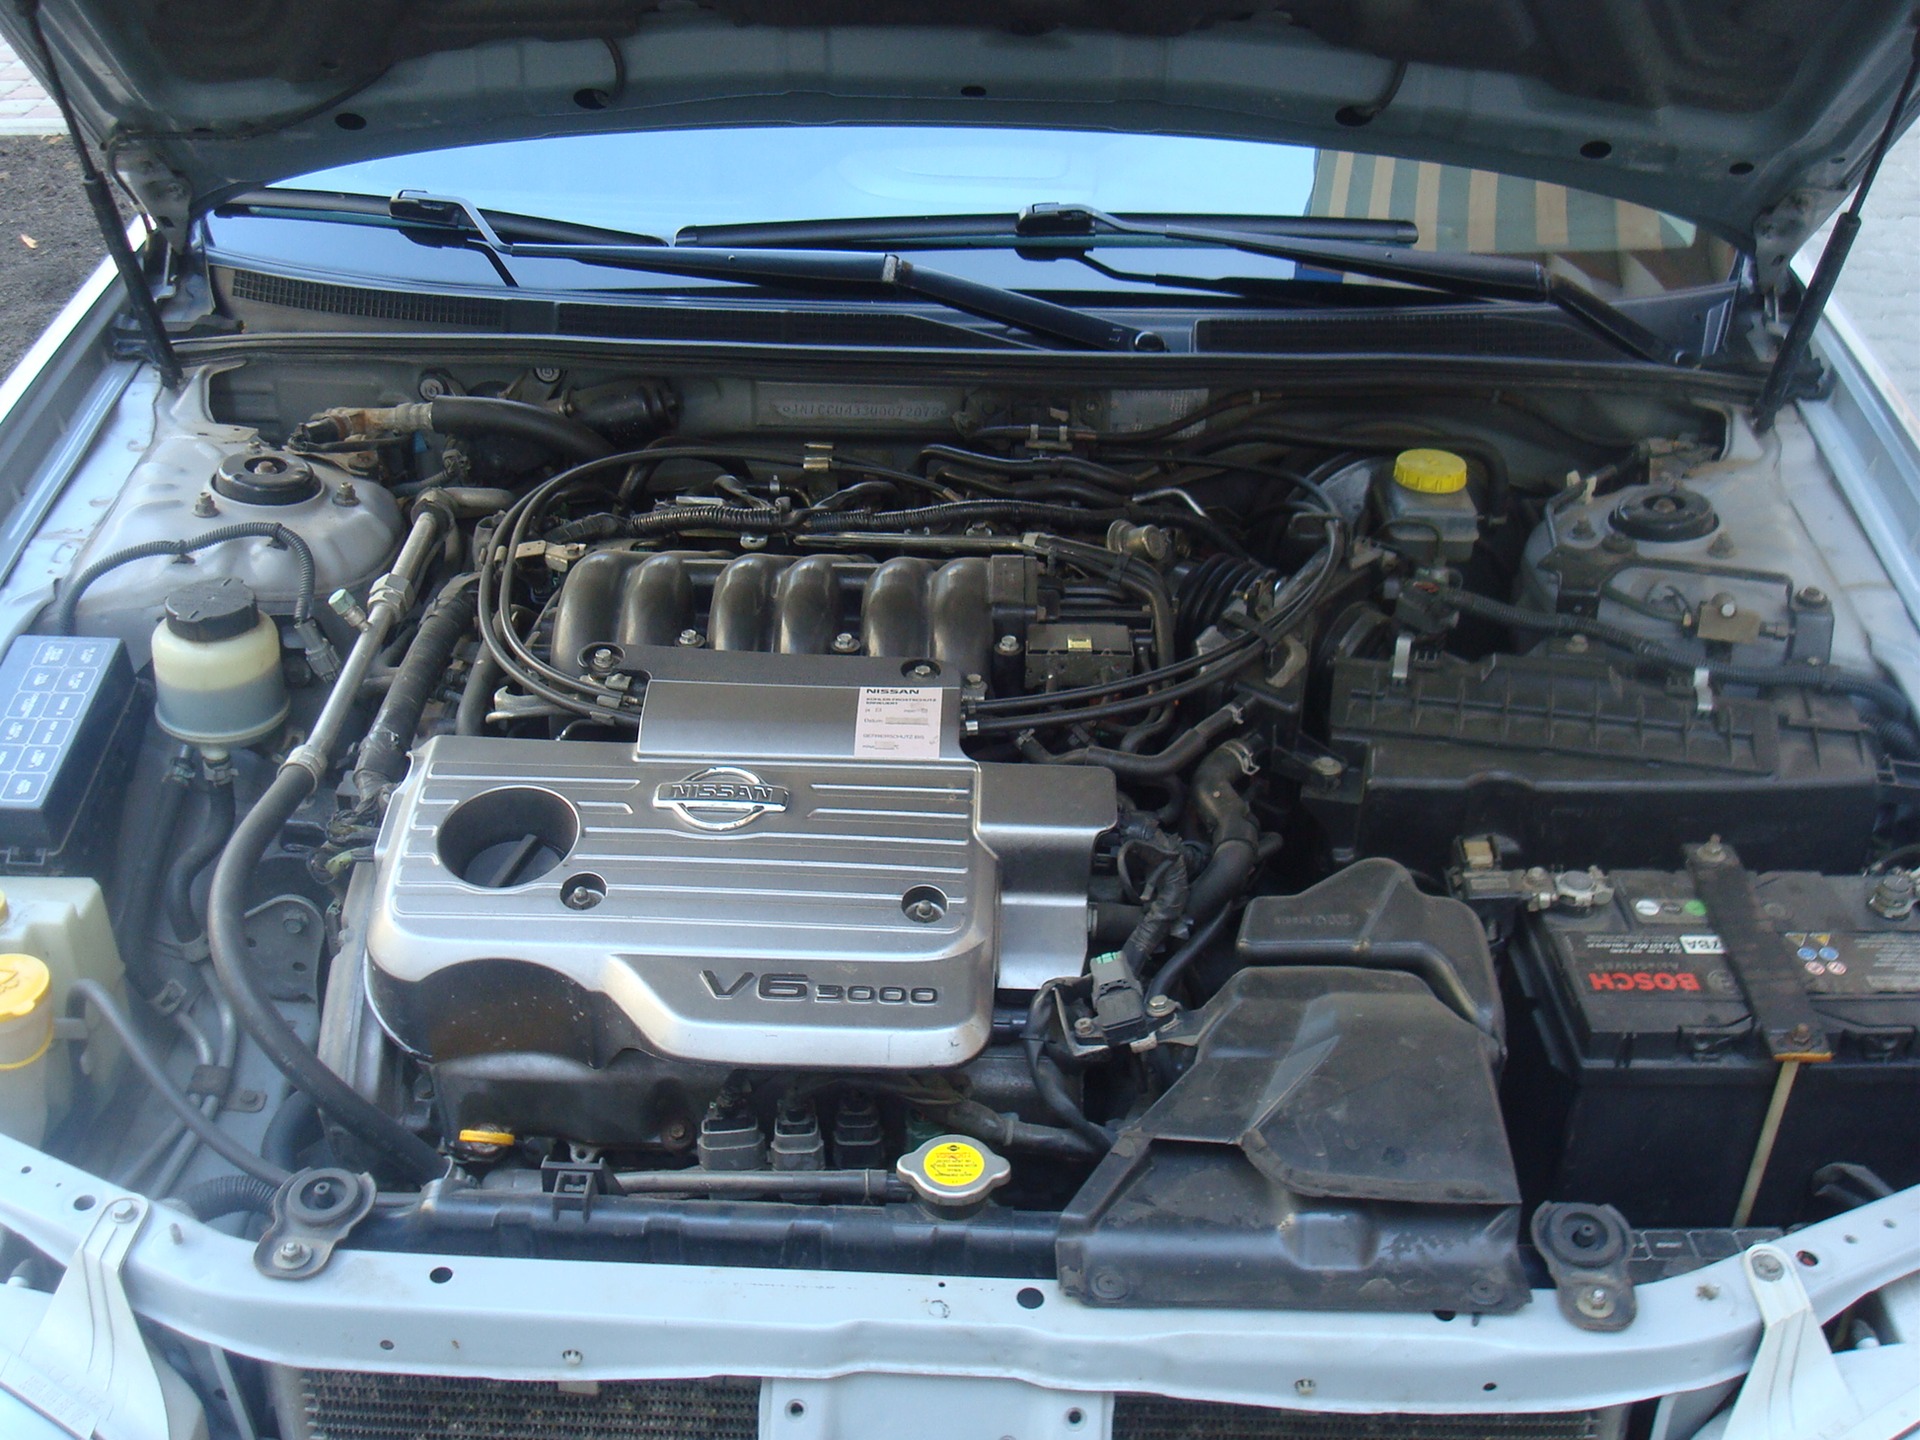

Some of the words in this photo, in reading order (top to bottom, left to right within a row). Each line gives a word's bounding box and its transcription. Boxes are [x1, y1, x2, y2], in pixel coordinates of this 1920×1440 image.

[671, 783, 774, 802] NISSAN
[699, 969, 809, 1000] V6
[814, 984, 938, 1005] 3000
[1589, 972, 1701, 991] BOSCH
